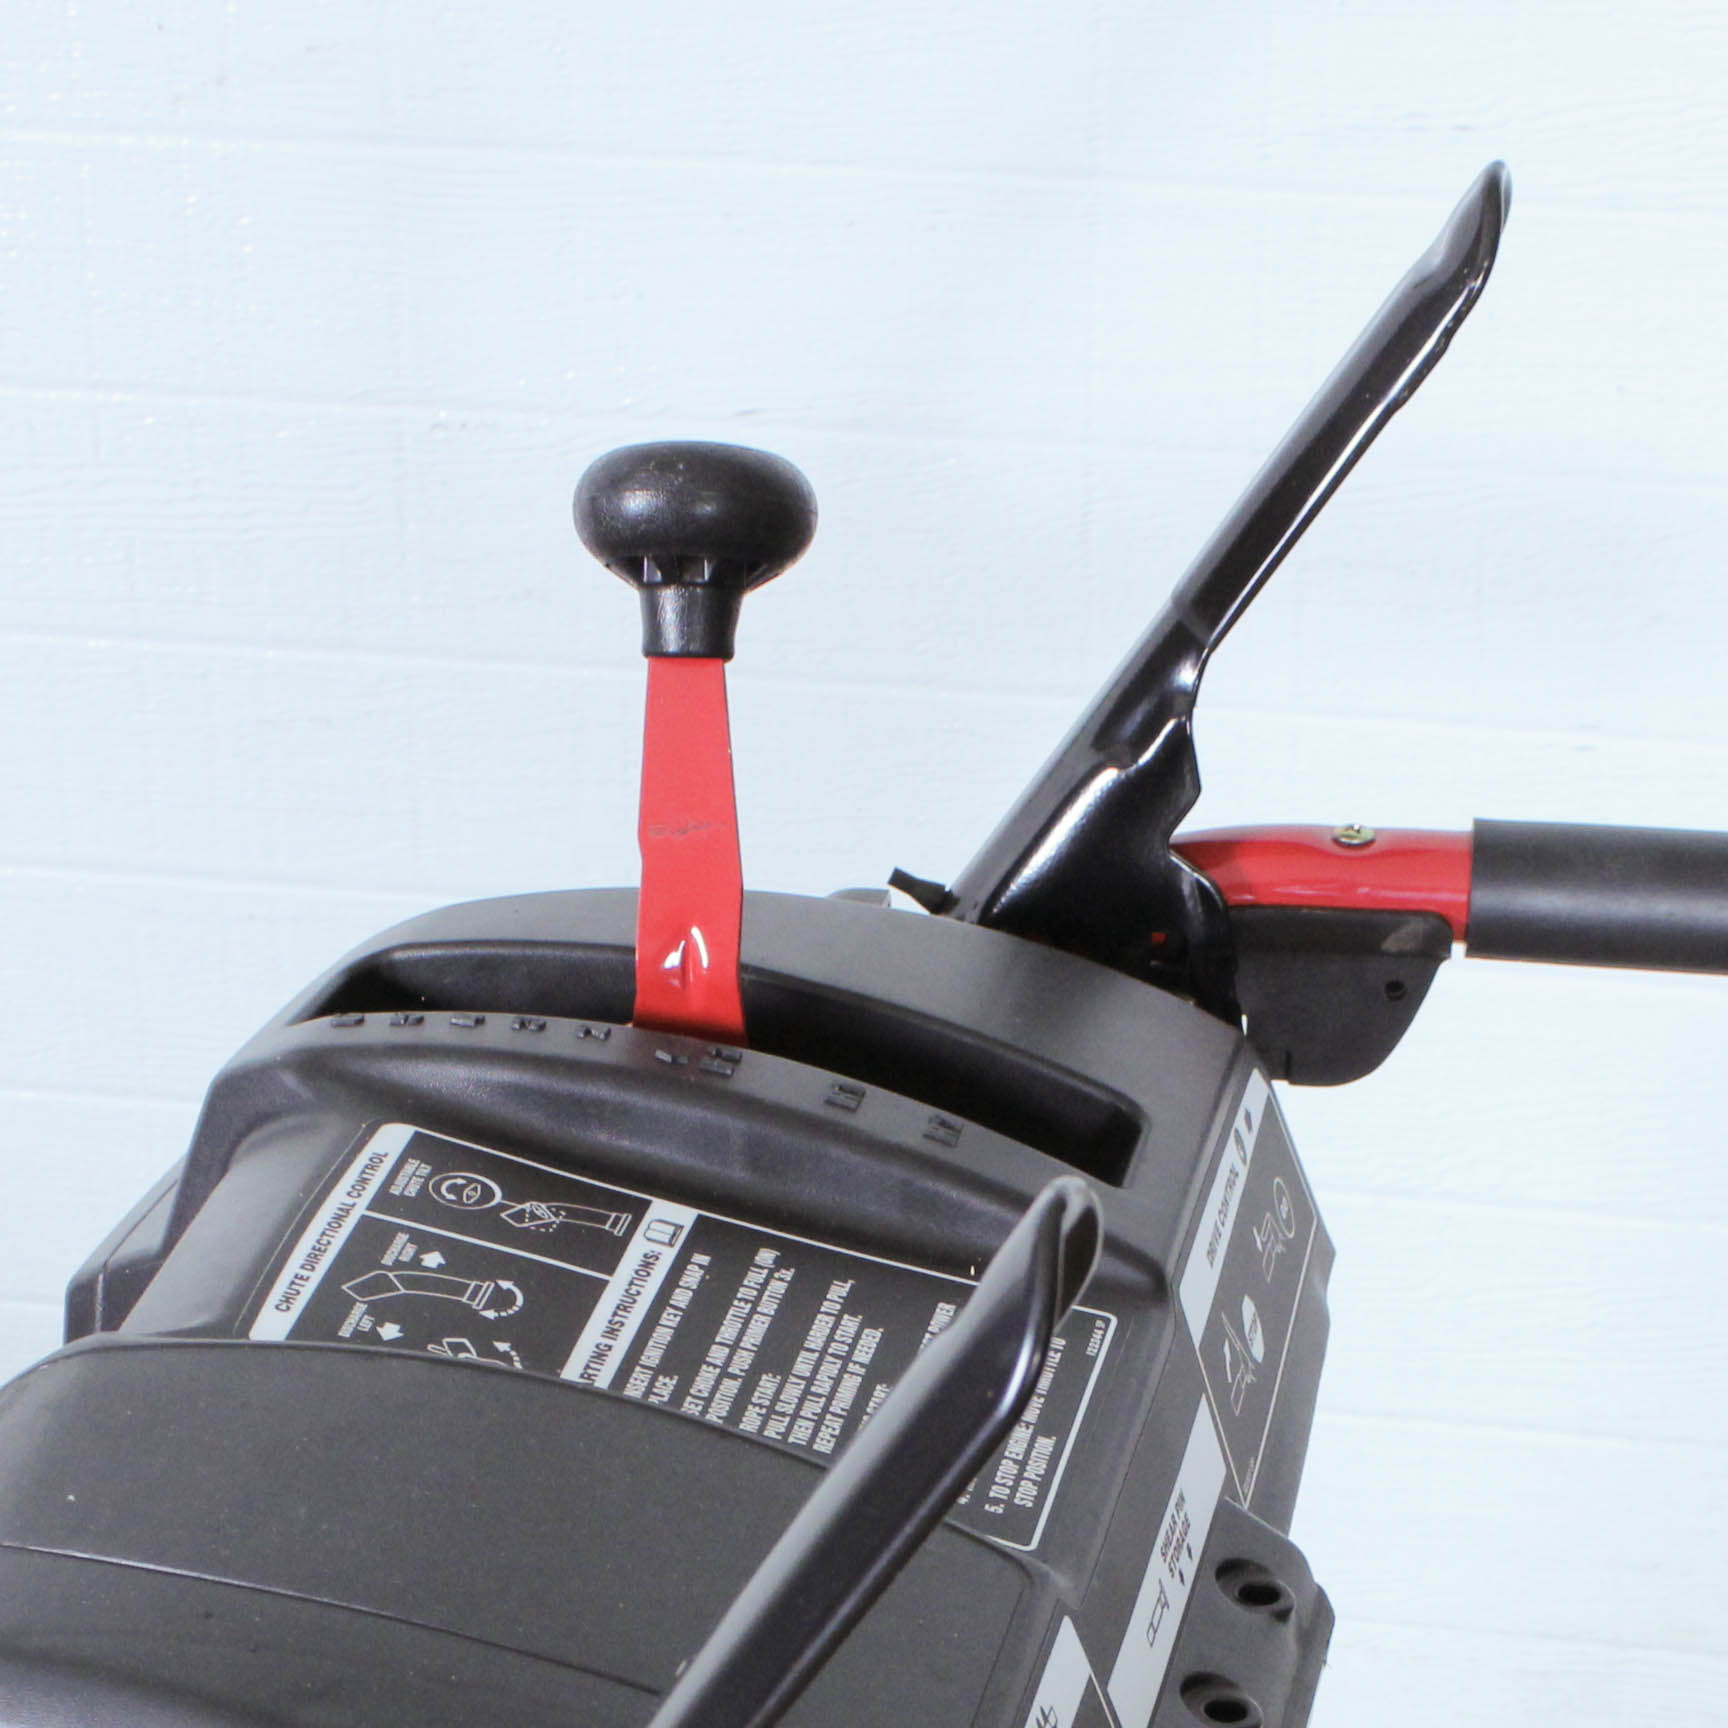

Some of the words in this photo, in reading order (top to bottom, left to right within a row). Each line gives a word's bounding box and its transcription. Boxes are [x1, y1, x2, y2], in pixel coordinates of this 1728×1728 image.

[275, 1272, 310, 1313] CHUTE
[300, 1201, 356, 1273] DIRECTIONAL
[347, 1151, 389, 1200] CONTROL
[690, 1253, 711, 1266] IN
[678, 1264, 705, 1289] SNAP
[743, 1266, 769, 1289] FULL
[826, 1279, 855, 1303] PULL,
[600, 1250, 663, 1341] INSTRUCTIONS:
[669, 1288, 694, 1309] AND
[736, 1287, 758, 1301] TO
[756, 1278, 788, 1316] BUTTON
[820, 1300, 841, 1315] TO
[658, 1306, 683, 1328] KEY
[715, 1299, 753, 1345] THROTTLE
[834, 1313, 863, 1343] START.
[739, 1314, 772, 1351] PRIMER
[803, 1313, 836, 1351] HARDER
[852, 1328, 884, 1364] NEEDED.
[638, 1325, 675, 1369] IGNITION
[706, 1344, 730, 1366] AND
[827, 1342, 849, 1356] TO
[728, 1348, 755, 1376] PUSH
[791, 1350, 820, 1377] UNTIL
[810, 1354, 842, 1396] RAPIDLY
[846, 1362, 866, 1375] IF
[689, 1364, 721, 1397] CHOKE
[751, 1373, 782, 1407] START:
[774, 1375, 806, 1414] SLOWLY
[829, 1373, 862, 1416] PRIMING
[705, 1377, 743, 1424] POSITION.
[800, 1395, 826, 1420] PULL
[739, 1404, 767, 1433] ROPE
[763, 1414, 791, 1440] PULL
[787, 1419, 815, 1445] THEN
[812, 1413, 844, 1454] REPEAT
[995, 1458, 1020, 1487] STOP
[1023, 1435, 1057, 1481] POSITION.
[988, 1485, 1011, 1500] TO
[1014, 1479, 1039, 1508] STOP
[984, 1503, 1005, 1514] 5.
